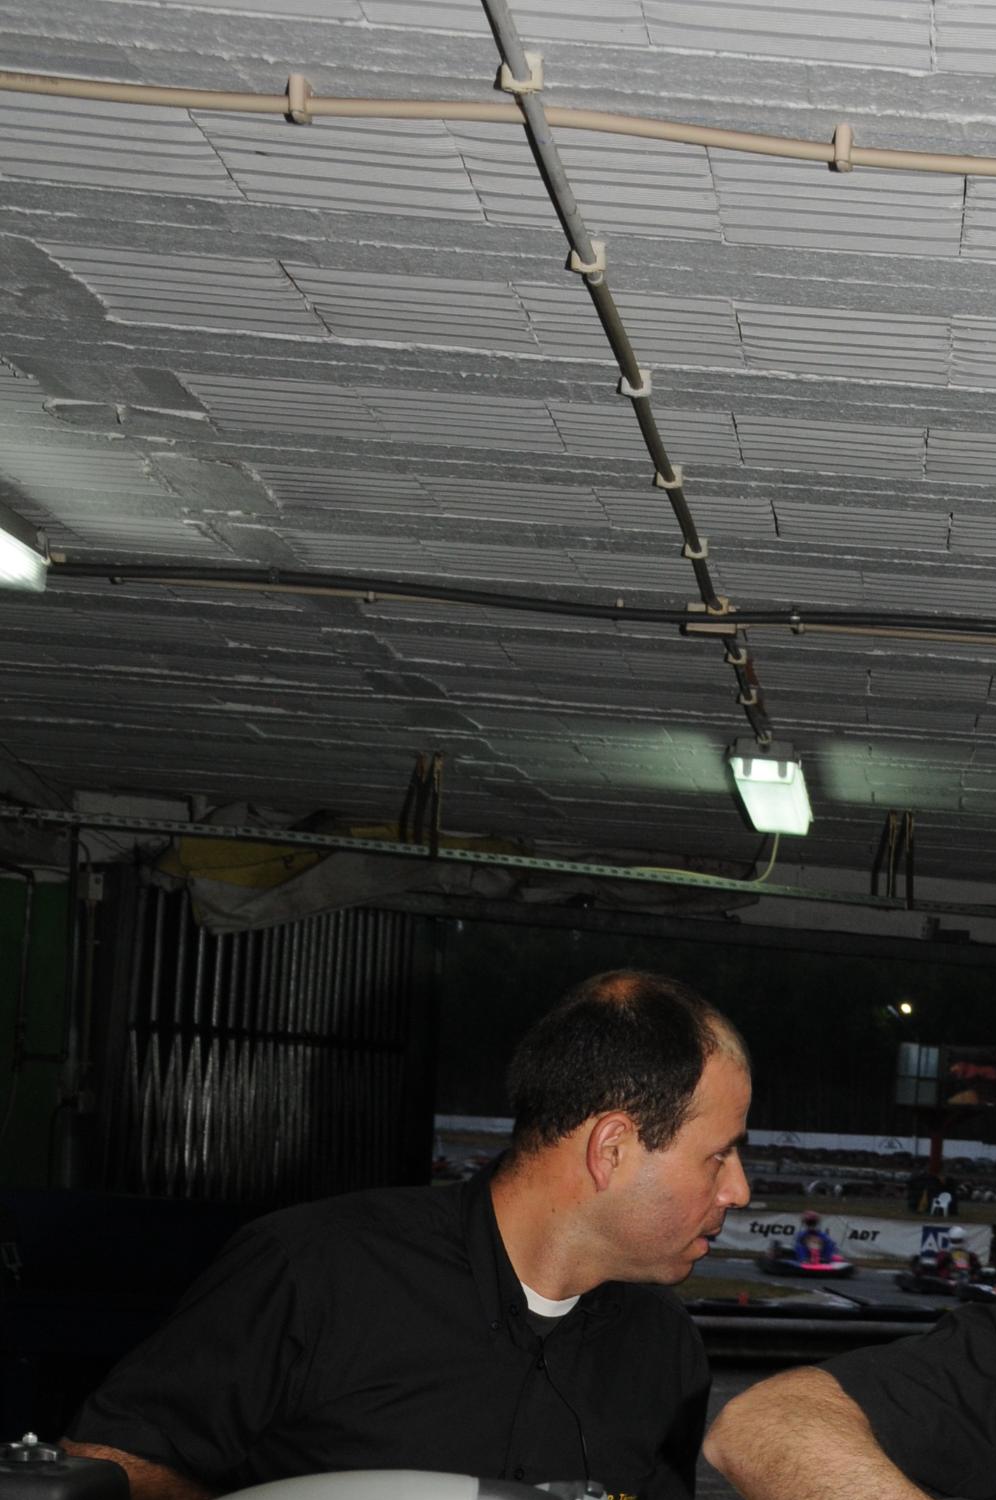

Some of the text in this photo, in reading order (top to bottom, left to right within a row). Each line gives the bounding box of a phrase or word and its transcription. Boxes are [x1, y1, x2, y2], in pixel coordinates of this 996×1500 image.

[750, 1220, 795, 1238] tyco
[849, 1229, 880, 1242] ADT
[920, 1231, 949, 1253] AD
